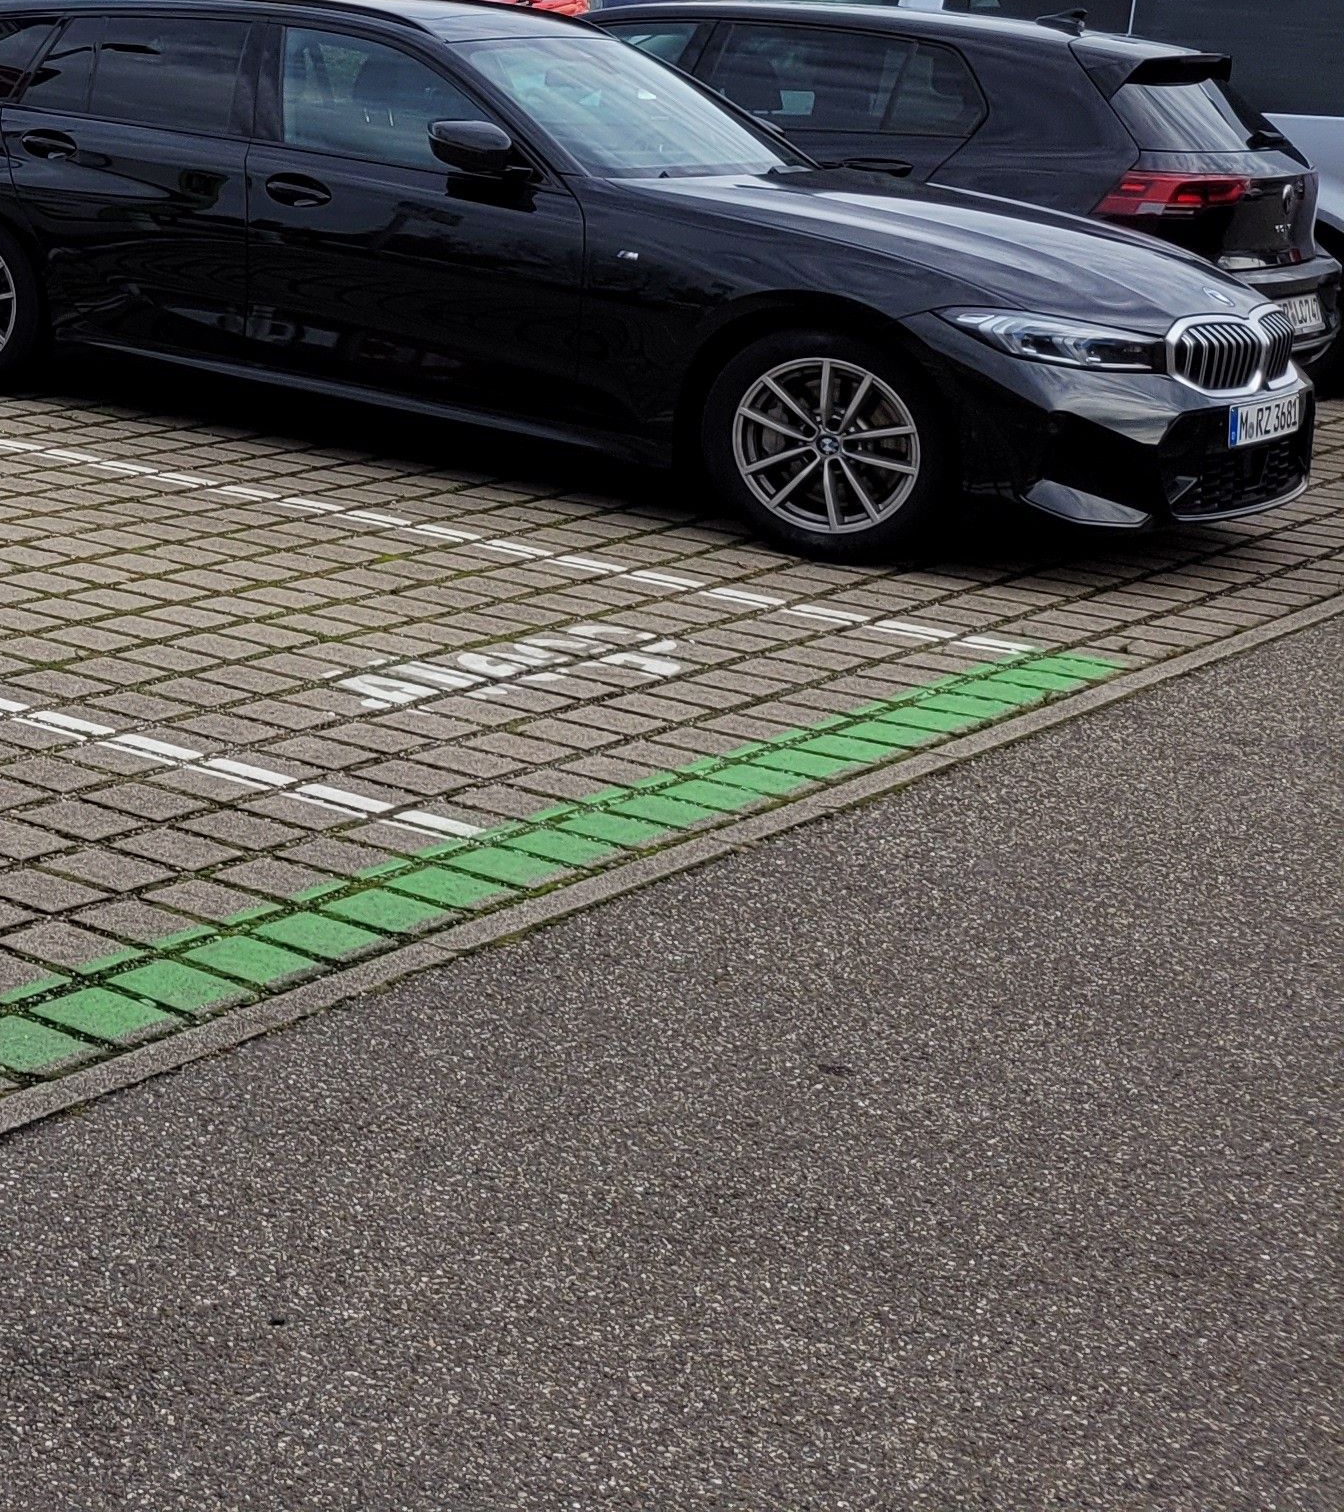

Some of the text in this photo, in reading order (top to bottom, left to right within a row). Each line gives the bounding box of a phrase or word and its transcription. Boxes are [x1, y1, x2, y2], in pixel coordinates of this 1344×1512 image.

[1239, 399, 1298, 440] M RZ 3681
